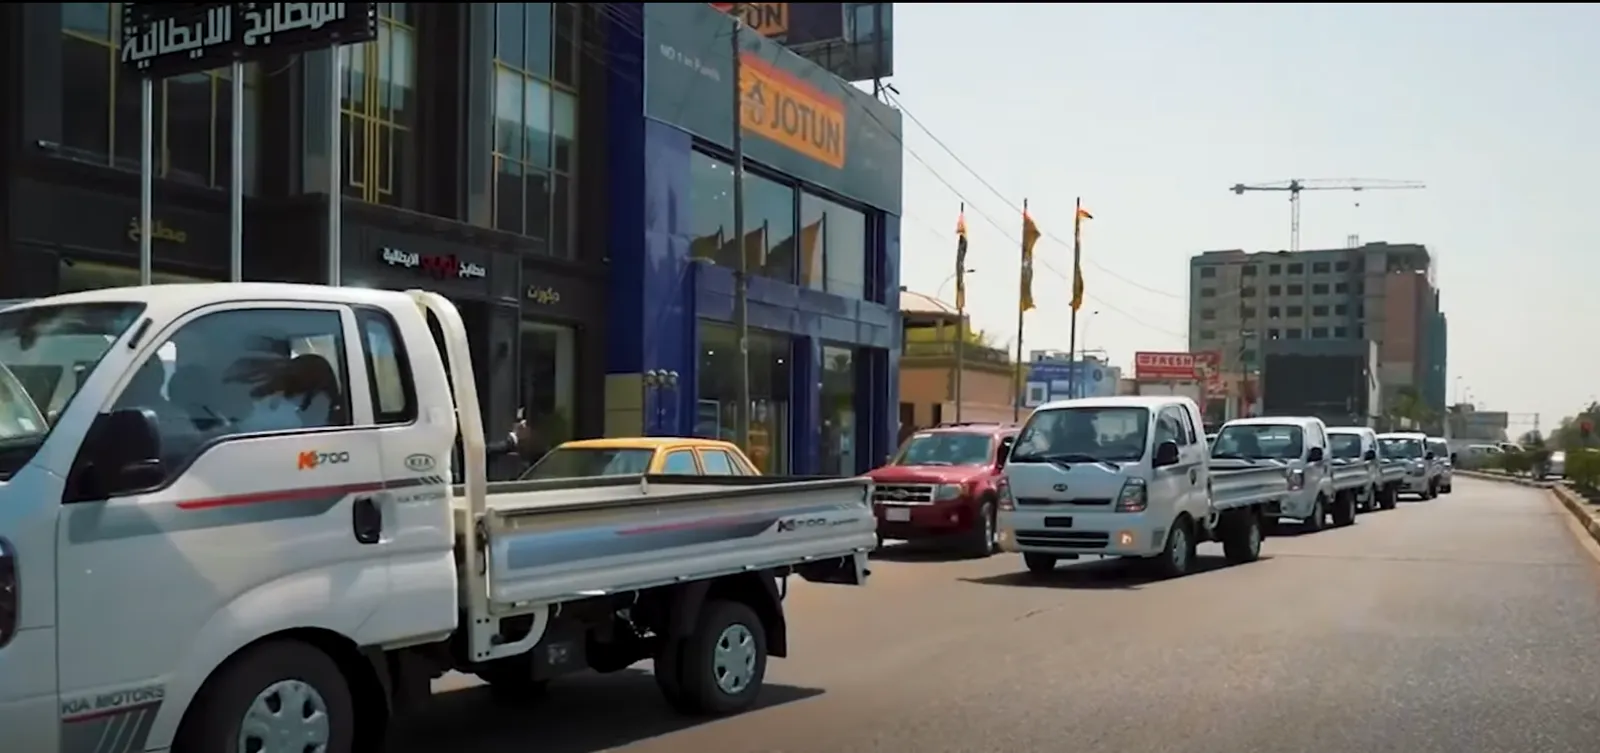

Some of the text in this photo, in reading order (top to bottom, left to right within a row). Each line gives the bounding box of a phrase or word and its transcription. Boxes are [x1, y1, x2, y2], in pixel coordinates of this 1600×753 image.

[771, 93, 841, 157] JOTUN
[61, 684, 166, 715] KIA MOTORS
